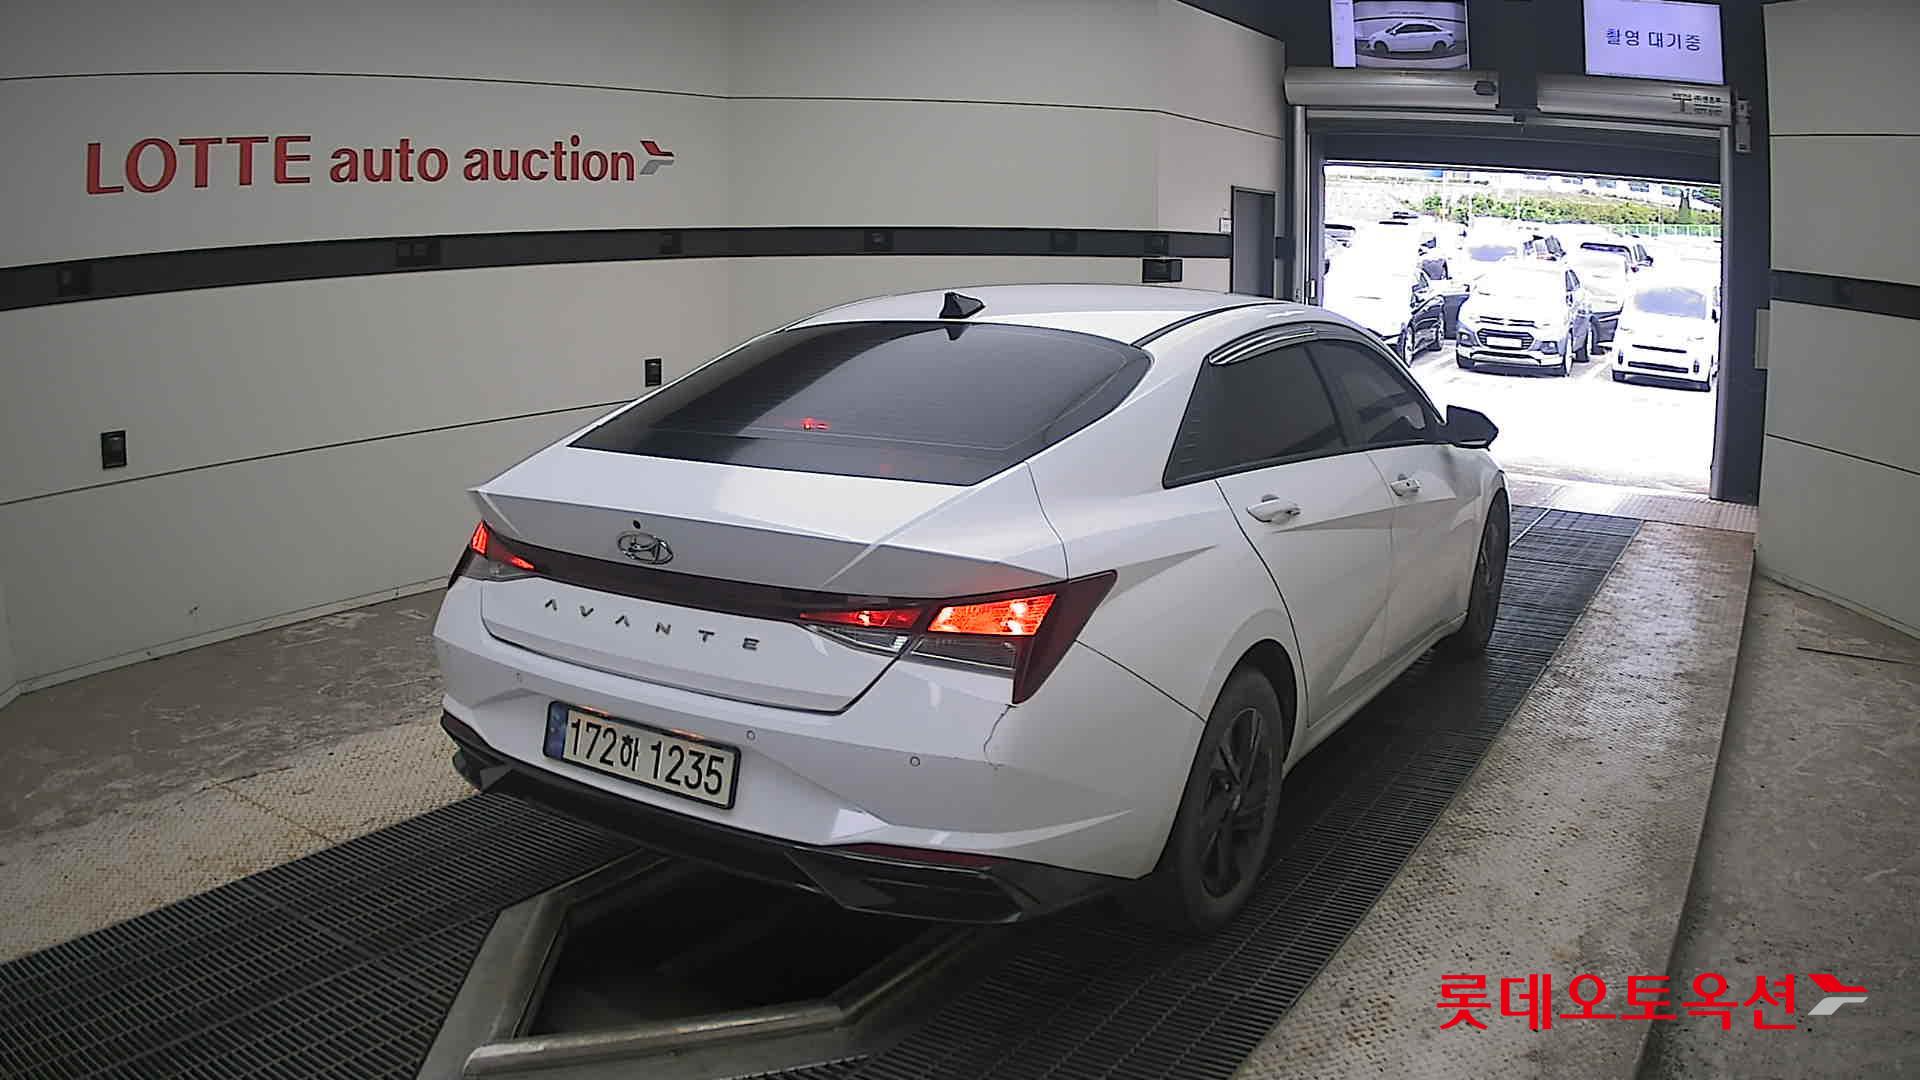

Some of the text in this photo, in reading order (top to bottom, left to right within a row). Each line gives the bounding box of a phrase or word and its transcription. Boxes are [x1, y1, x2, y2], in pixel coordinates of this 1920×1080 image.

[1648, 31, 1702, 52] 대기중
[86, 134, 635, 195] LOTTE auto auction
[544, 599, 761, 651] AVANTE
[570, 718, 725, 796] 172하 1235
